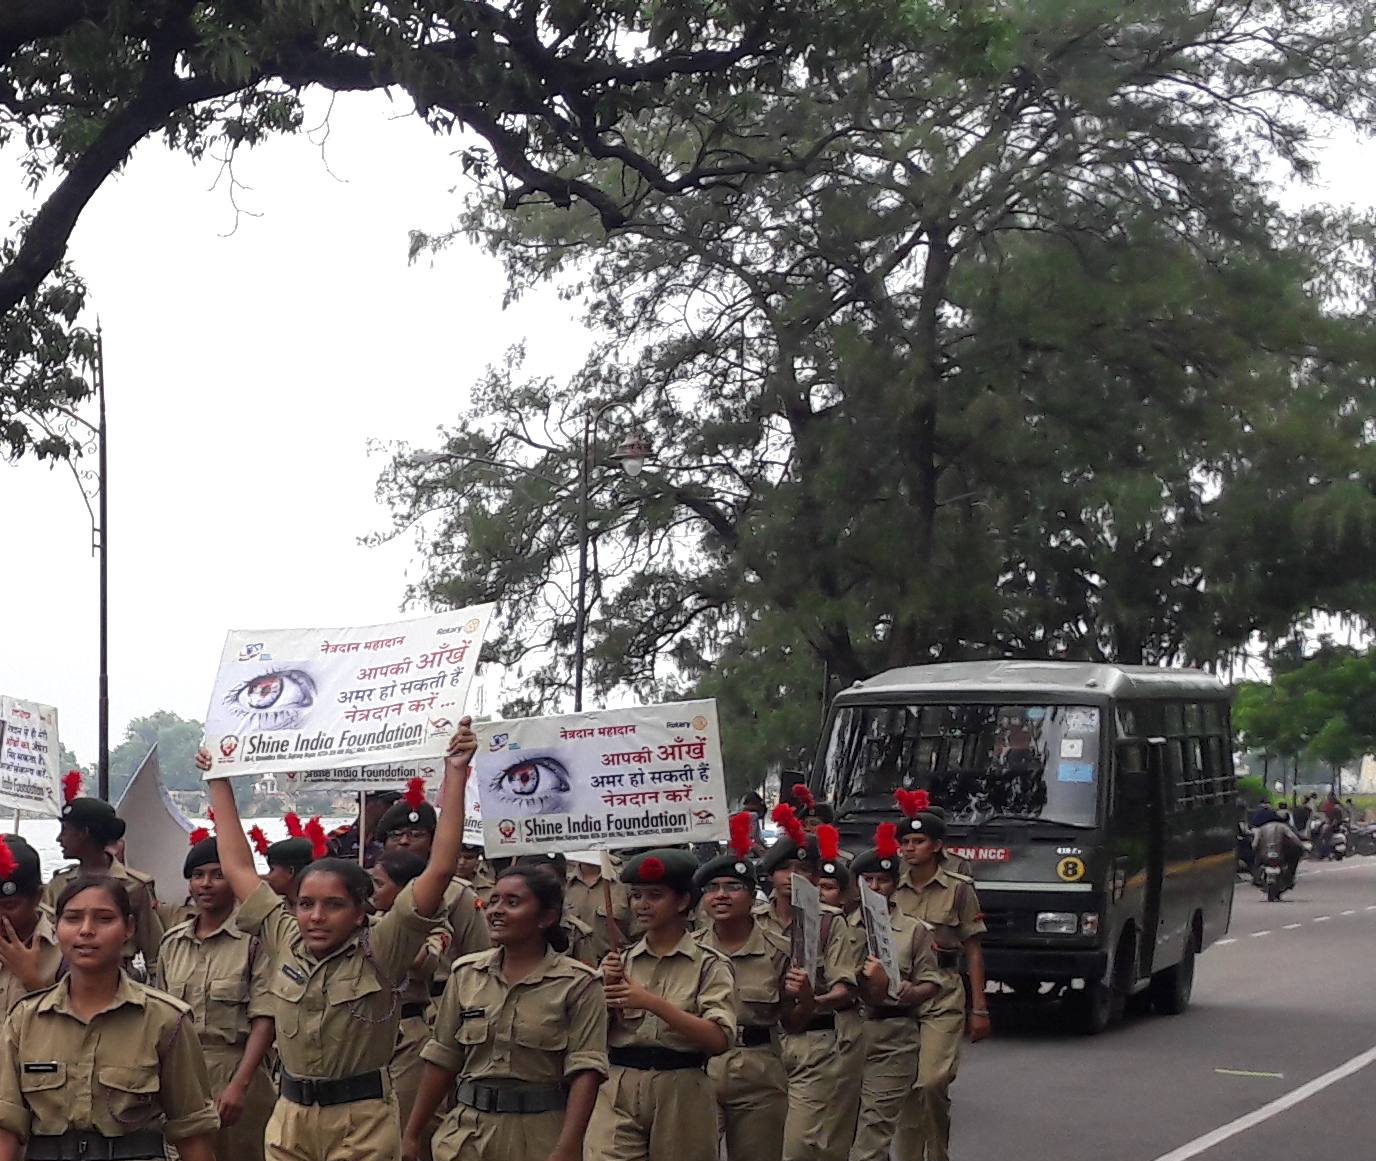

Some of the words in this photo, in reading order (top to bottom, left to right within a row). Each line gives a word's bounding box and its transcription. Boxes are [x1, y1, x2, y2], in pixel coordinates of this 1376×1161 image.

[321, 640, 359, 654] नेत्रदान
[363, 635, 406, 652] महादान
[357, 657, 414, 681] आपकी
[416, 639, 472, 669] आँखें
[337, 688, 376, 704] अमर
[400, 670, 447, 696] सकती
[344, 703, 404, 723] नेत्रदान
[247, 734, 290, 755] Shine
[295, 732, 334, 752] India
[338, 722, 423, 748] Foundation
[560, 727, 594, 740] नेत्रदान
[598, 725, 637, 738] महादान
[601, 746, 653, 766] आपकी
[657, 736, 708, 761] आँखें
[361, 765, 416, 778] Foundation
[591, 774, 624, 788] अमर
[628, 768, 645, 787] हो
[649, 765, 695, 784] सकती
[602, 790, 660, 807] नेत्रदान
[525, 818, 562, 837] Shine
[567, 815, 601, 834] India
[606, 810, 687, 833] Foundation
[979, 848, 1005, 860] NCC
[1062, 860, 1079, 878] 8
